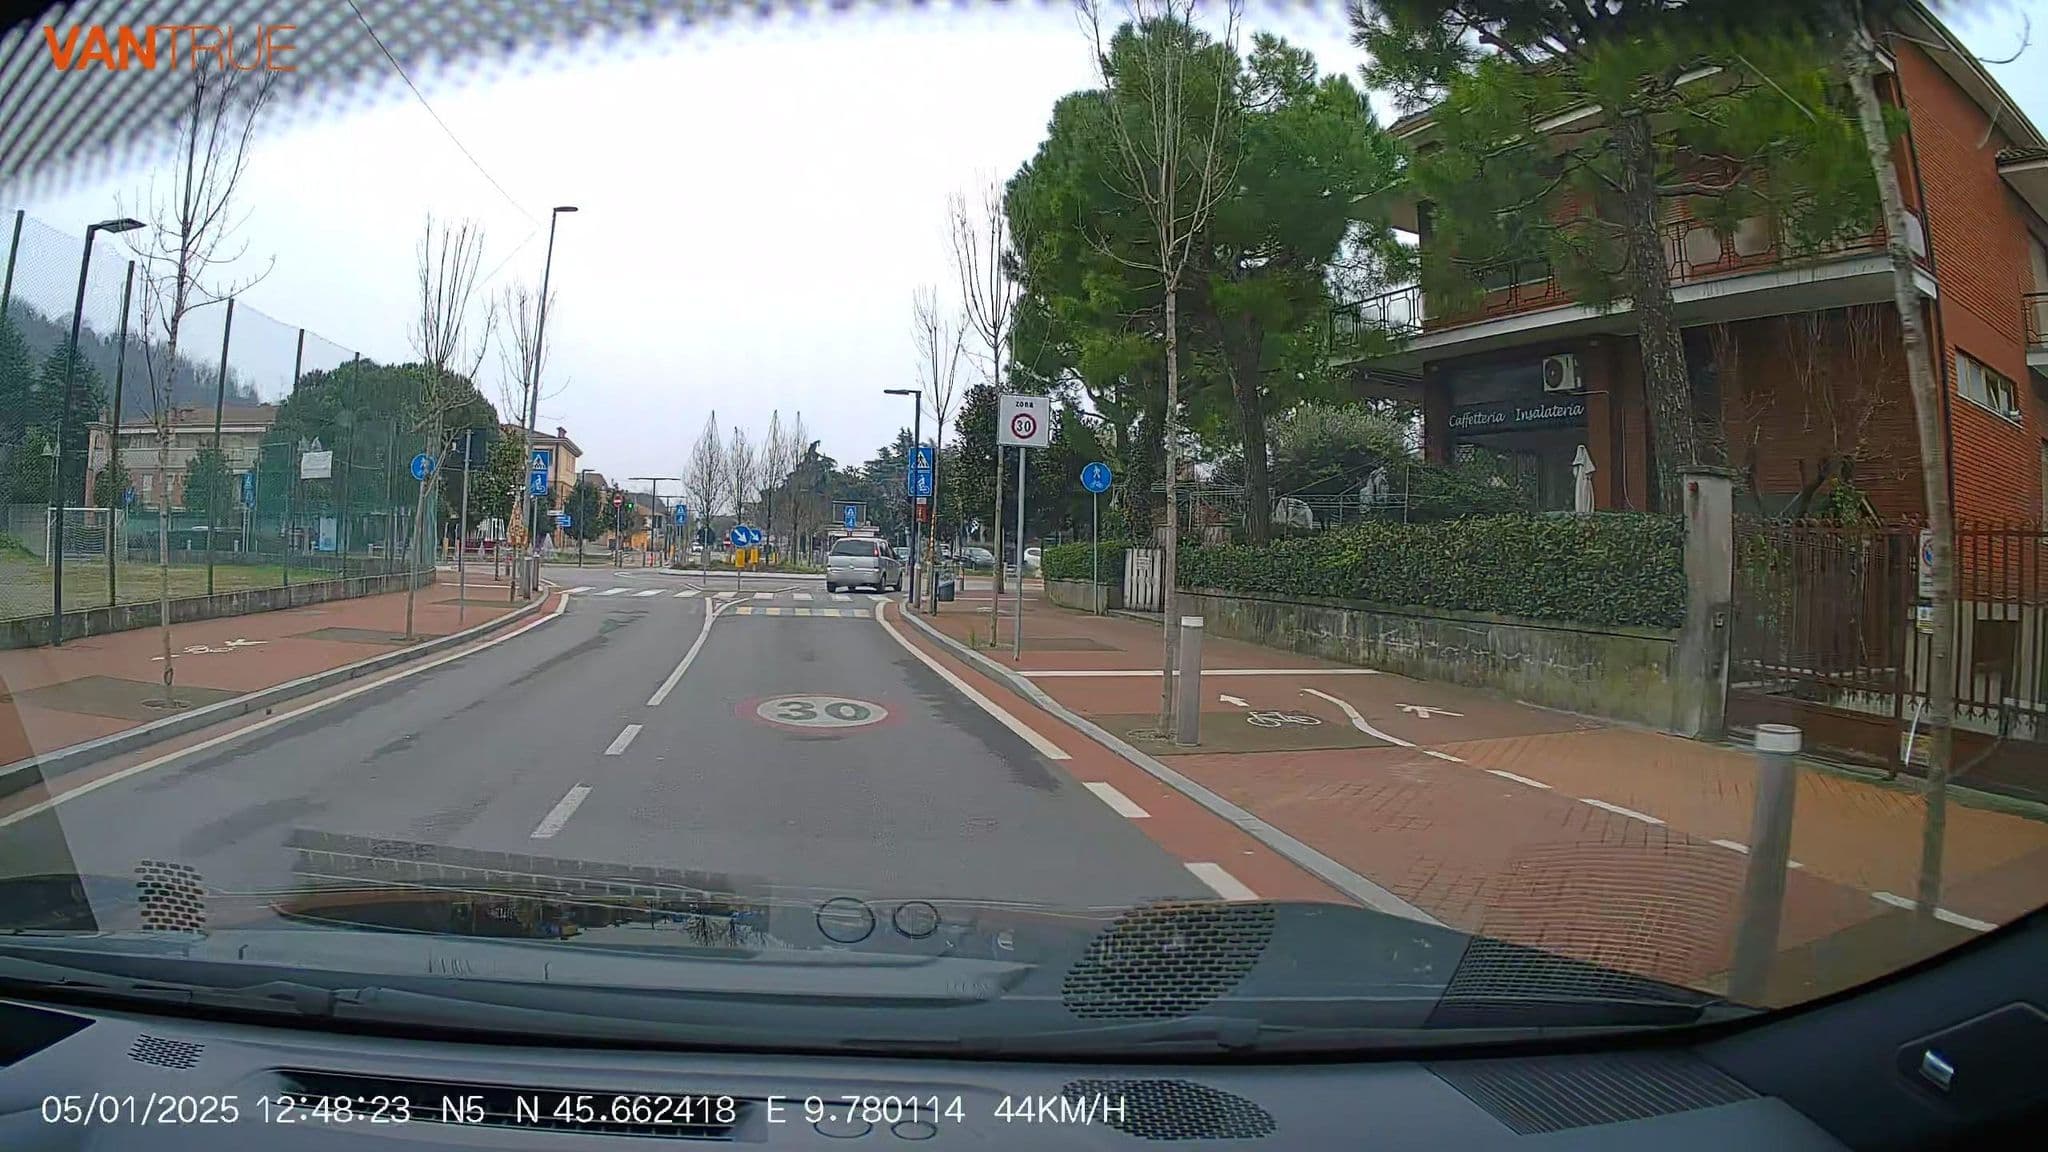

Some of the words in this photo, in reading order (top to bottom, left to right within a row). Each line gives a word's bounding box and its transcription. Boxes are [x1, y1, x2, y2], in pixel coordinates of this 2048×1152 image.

[1016, 420, 1031, 432] 30
[1449, 411, 1505, 428] Caffetteria
[1515, 404, 1584, 421] Insalateria
[777, 701, 871, 721] 30
